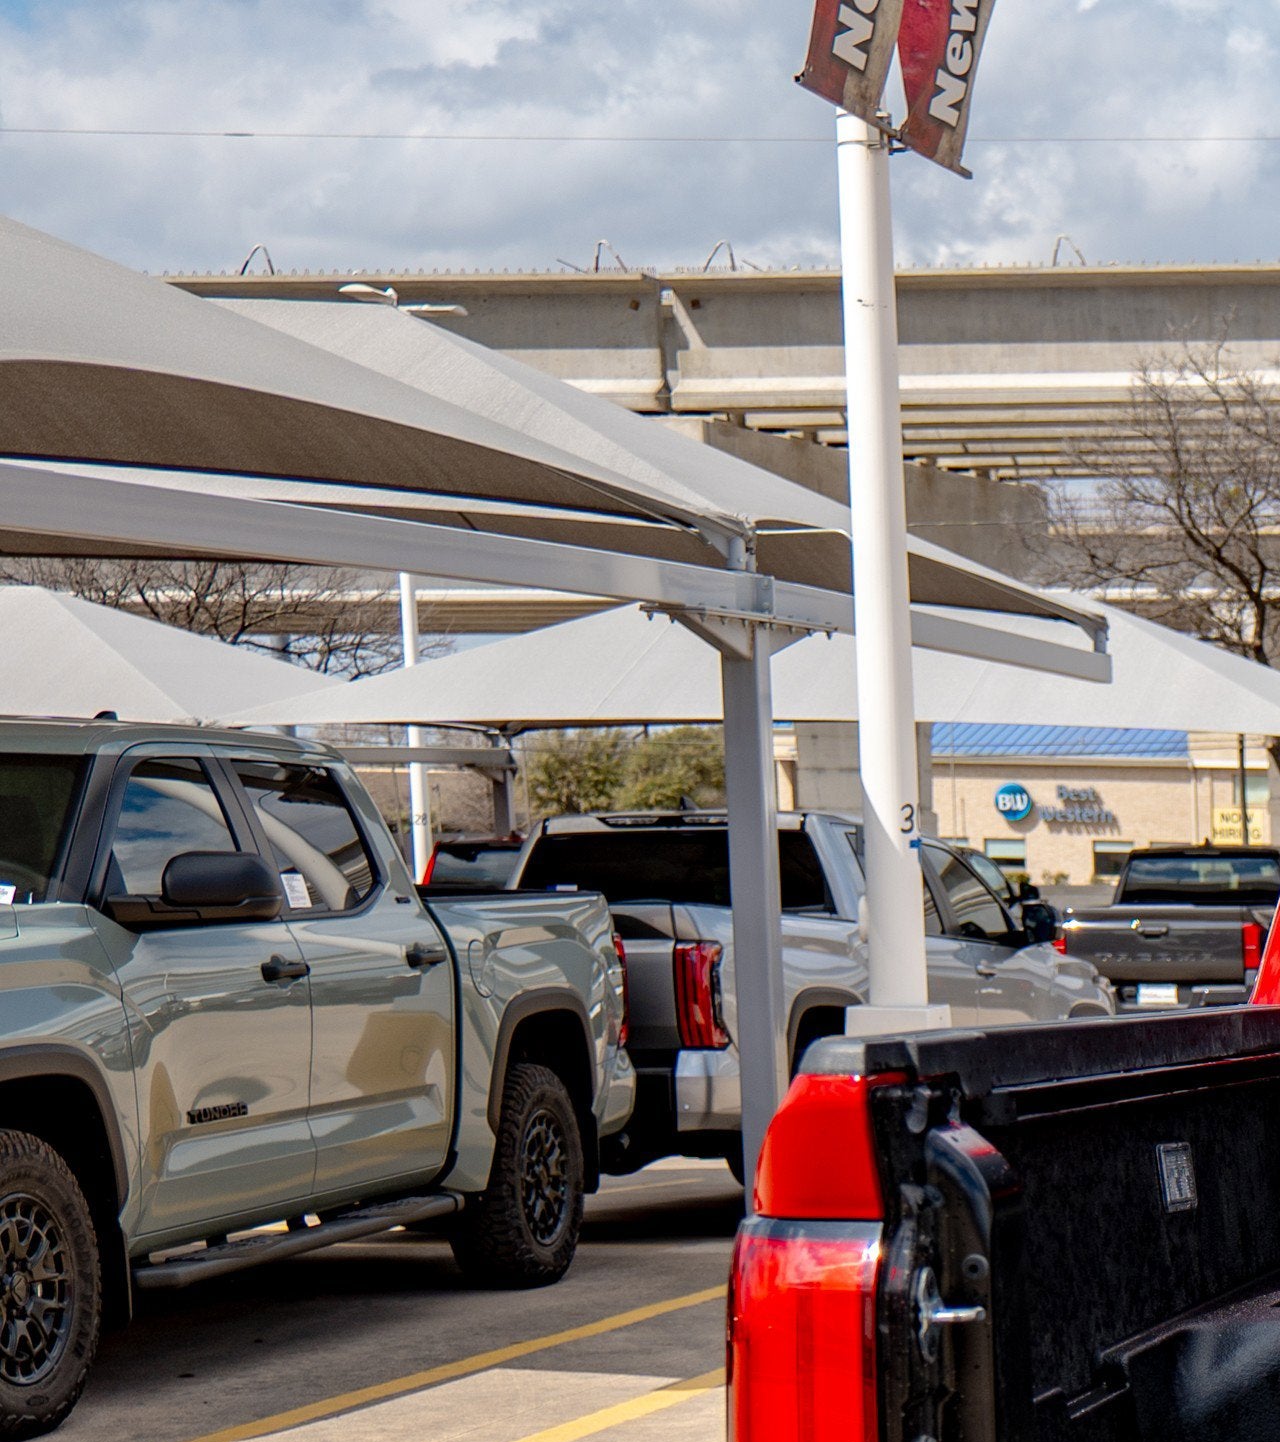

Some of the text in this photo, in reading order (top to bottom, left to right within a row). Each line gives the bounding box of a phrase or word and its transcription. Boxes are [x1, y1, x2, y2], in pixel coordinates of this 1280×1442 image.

[997, 793, 1028, 811] BW
[1056, 785, 1096, 801] Best
[900, 803, 914, 834] 3
[1039, 804, 1114, 823] Western
[1212, 827, 1262, 840] HIRIG
[186, 1101, 249, 1125] TUNDRA
